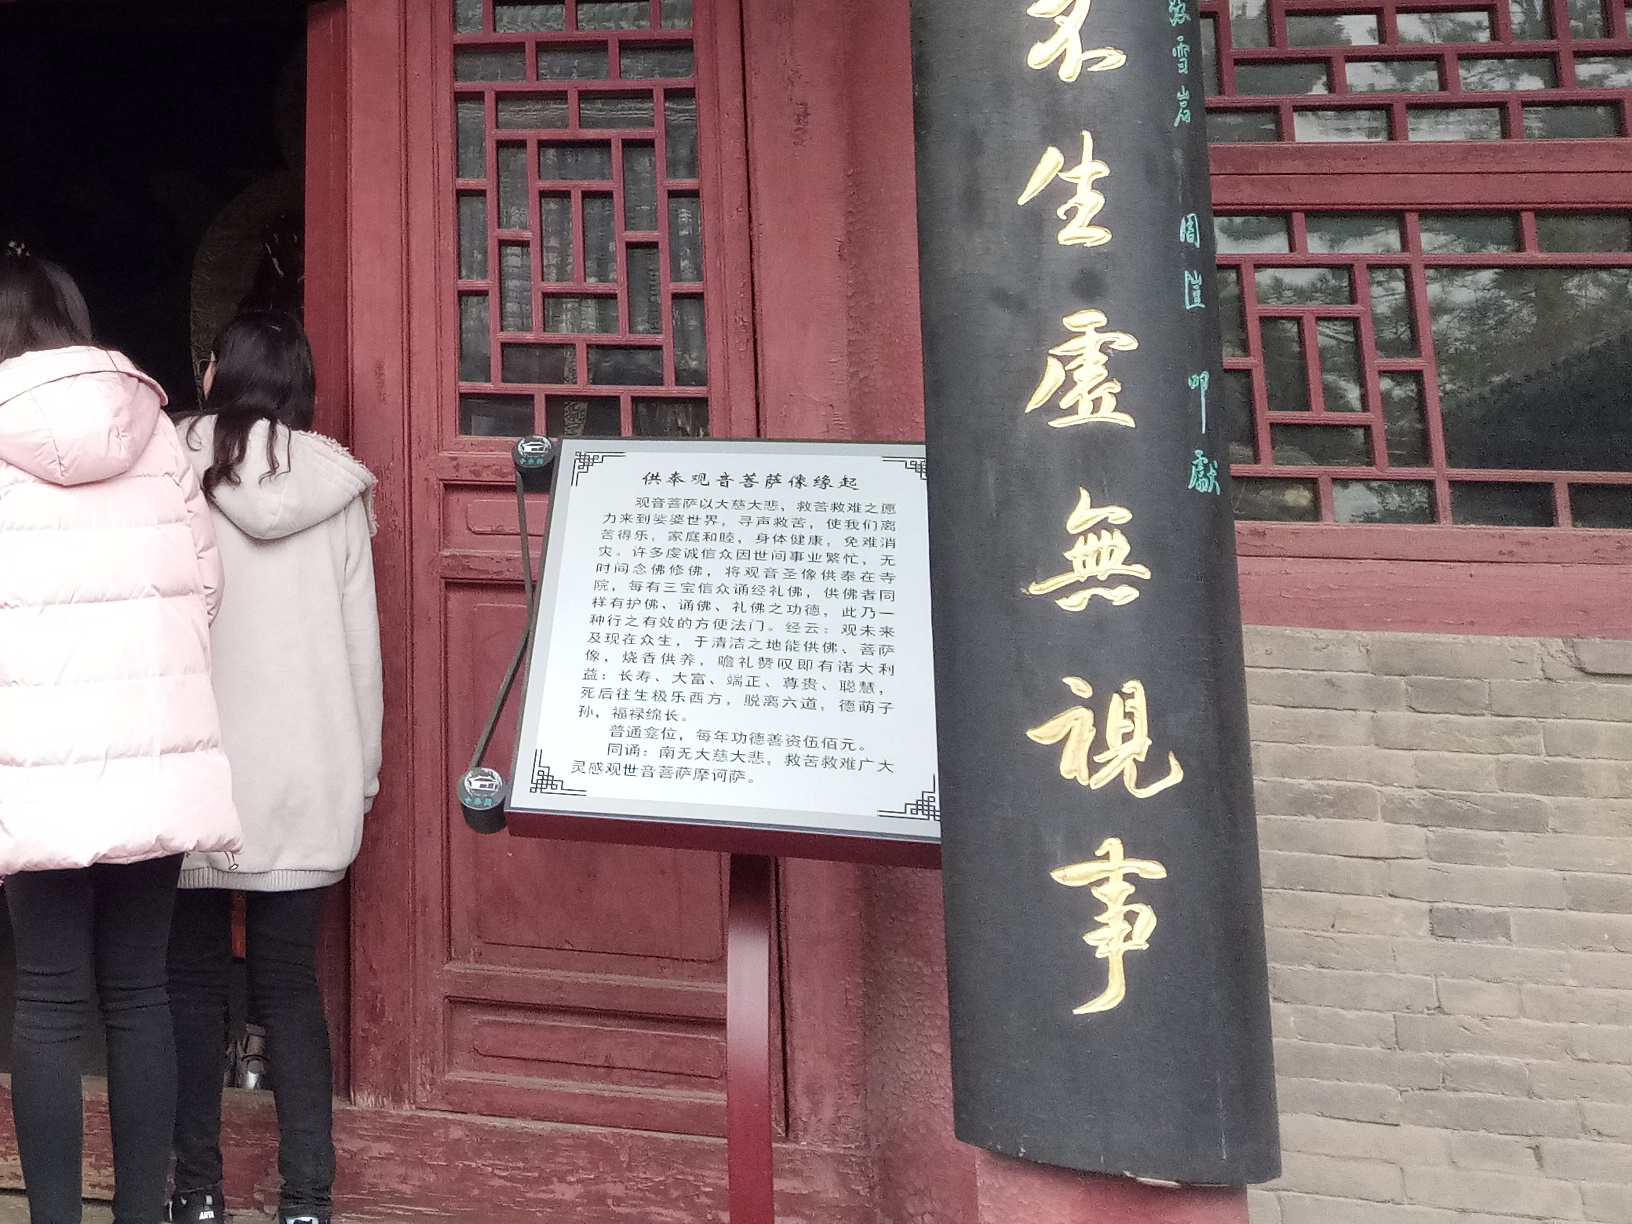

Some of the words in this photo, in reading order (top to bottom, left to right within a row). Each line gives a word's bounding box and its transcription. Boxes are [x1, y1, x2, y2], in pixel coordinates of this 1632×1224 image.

[642, 471, 859, 490] 供奉观音菩萨像缘起
